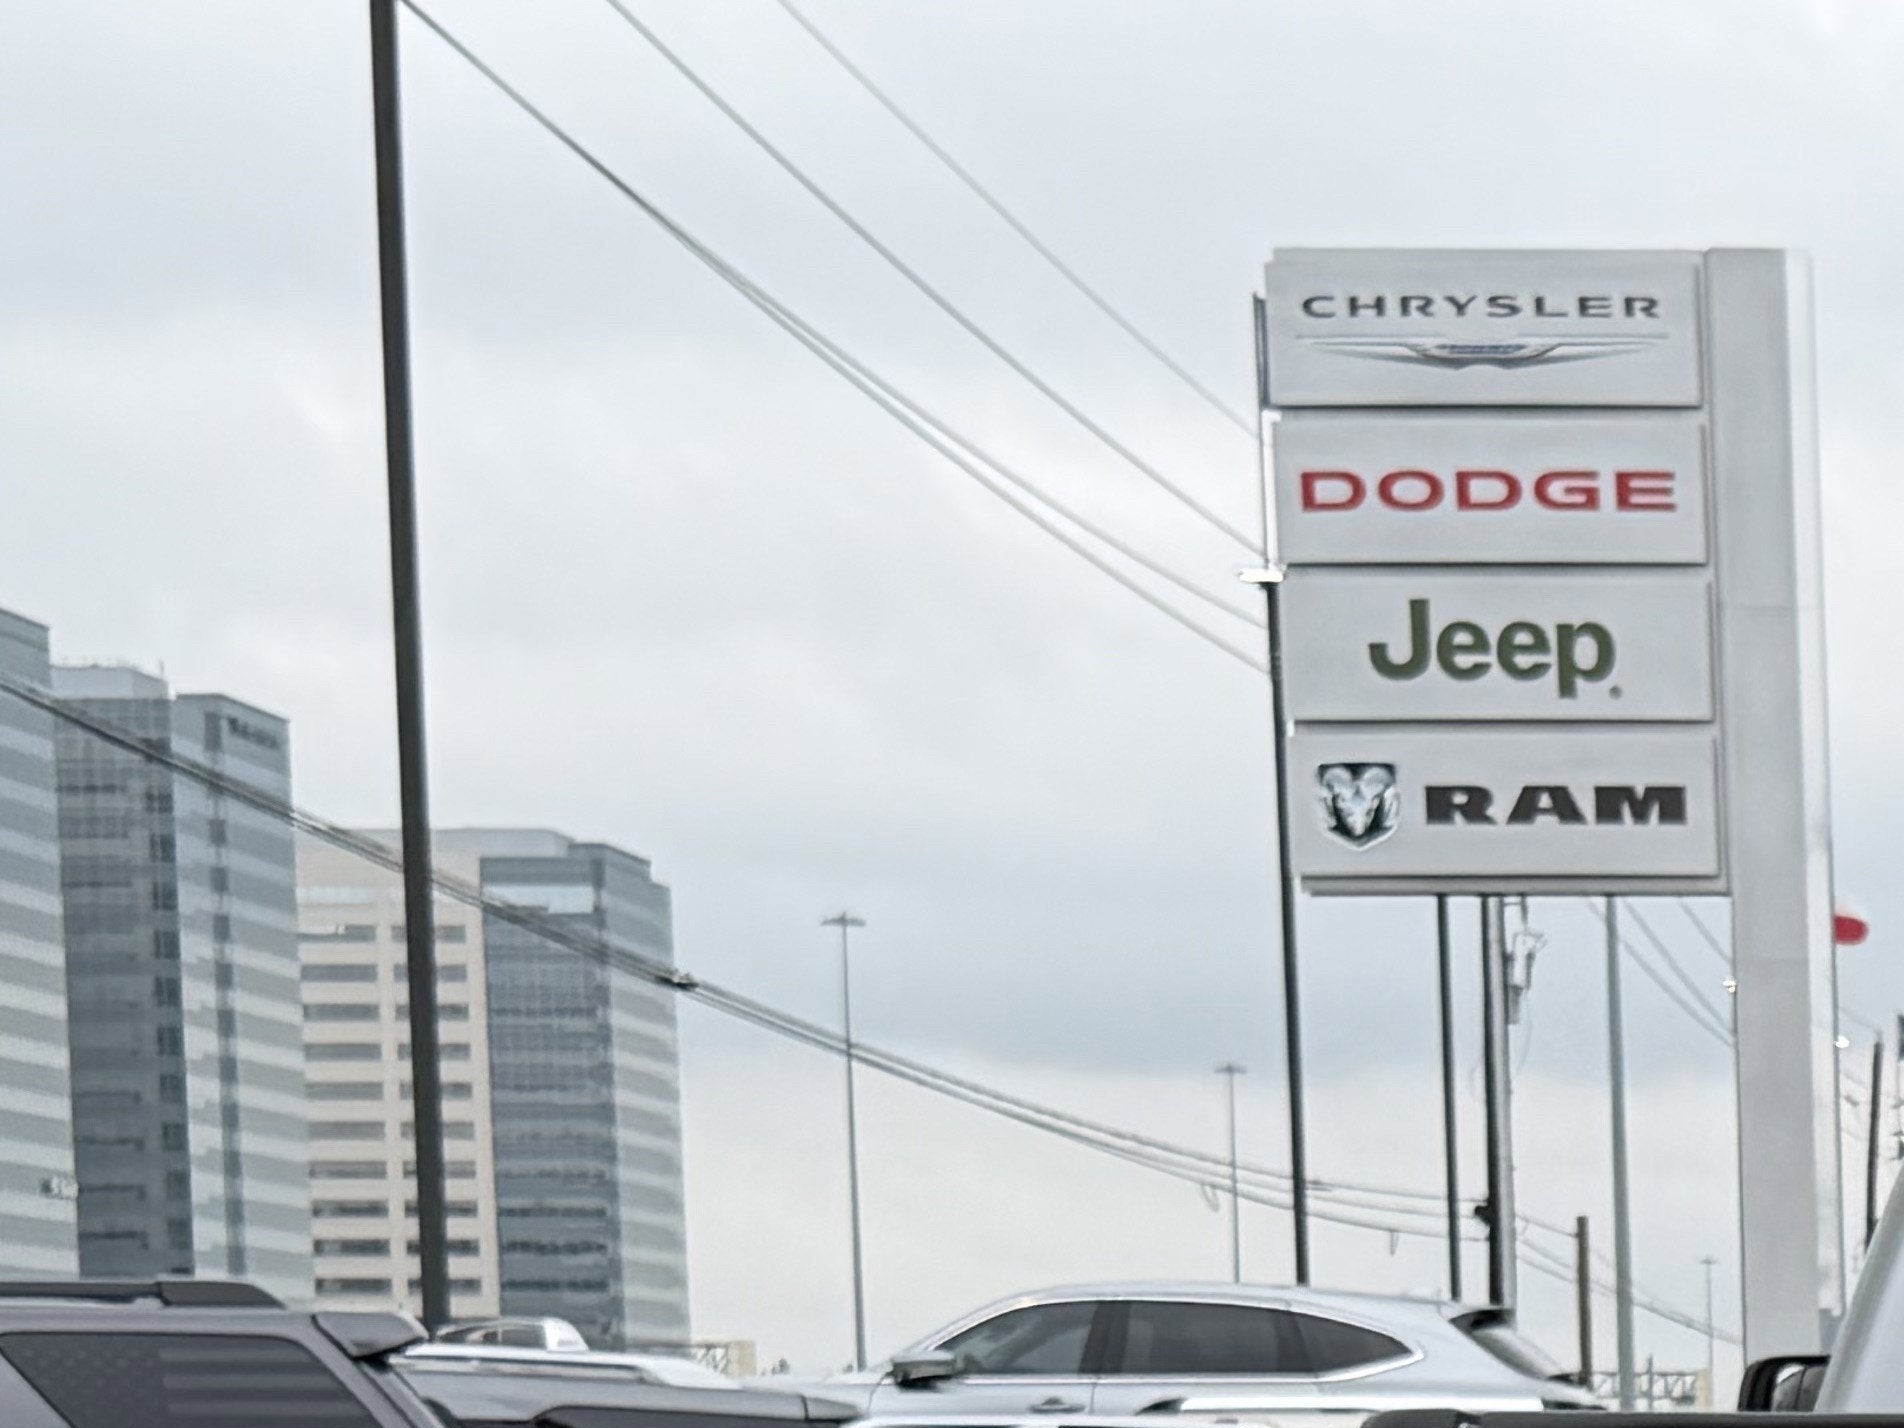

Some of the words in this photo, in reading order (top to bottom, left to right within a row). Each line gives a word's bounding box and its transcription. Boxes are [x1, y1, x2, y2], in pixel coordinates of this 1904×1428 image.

[1301, 294, 1661, 320] CHRYSLER
[1299, 469, 1677, 513] DODGE
[1368, 598, 1617, 698] Jeep
[1423, 784, 1687, 826] RAM
